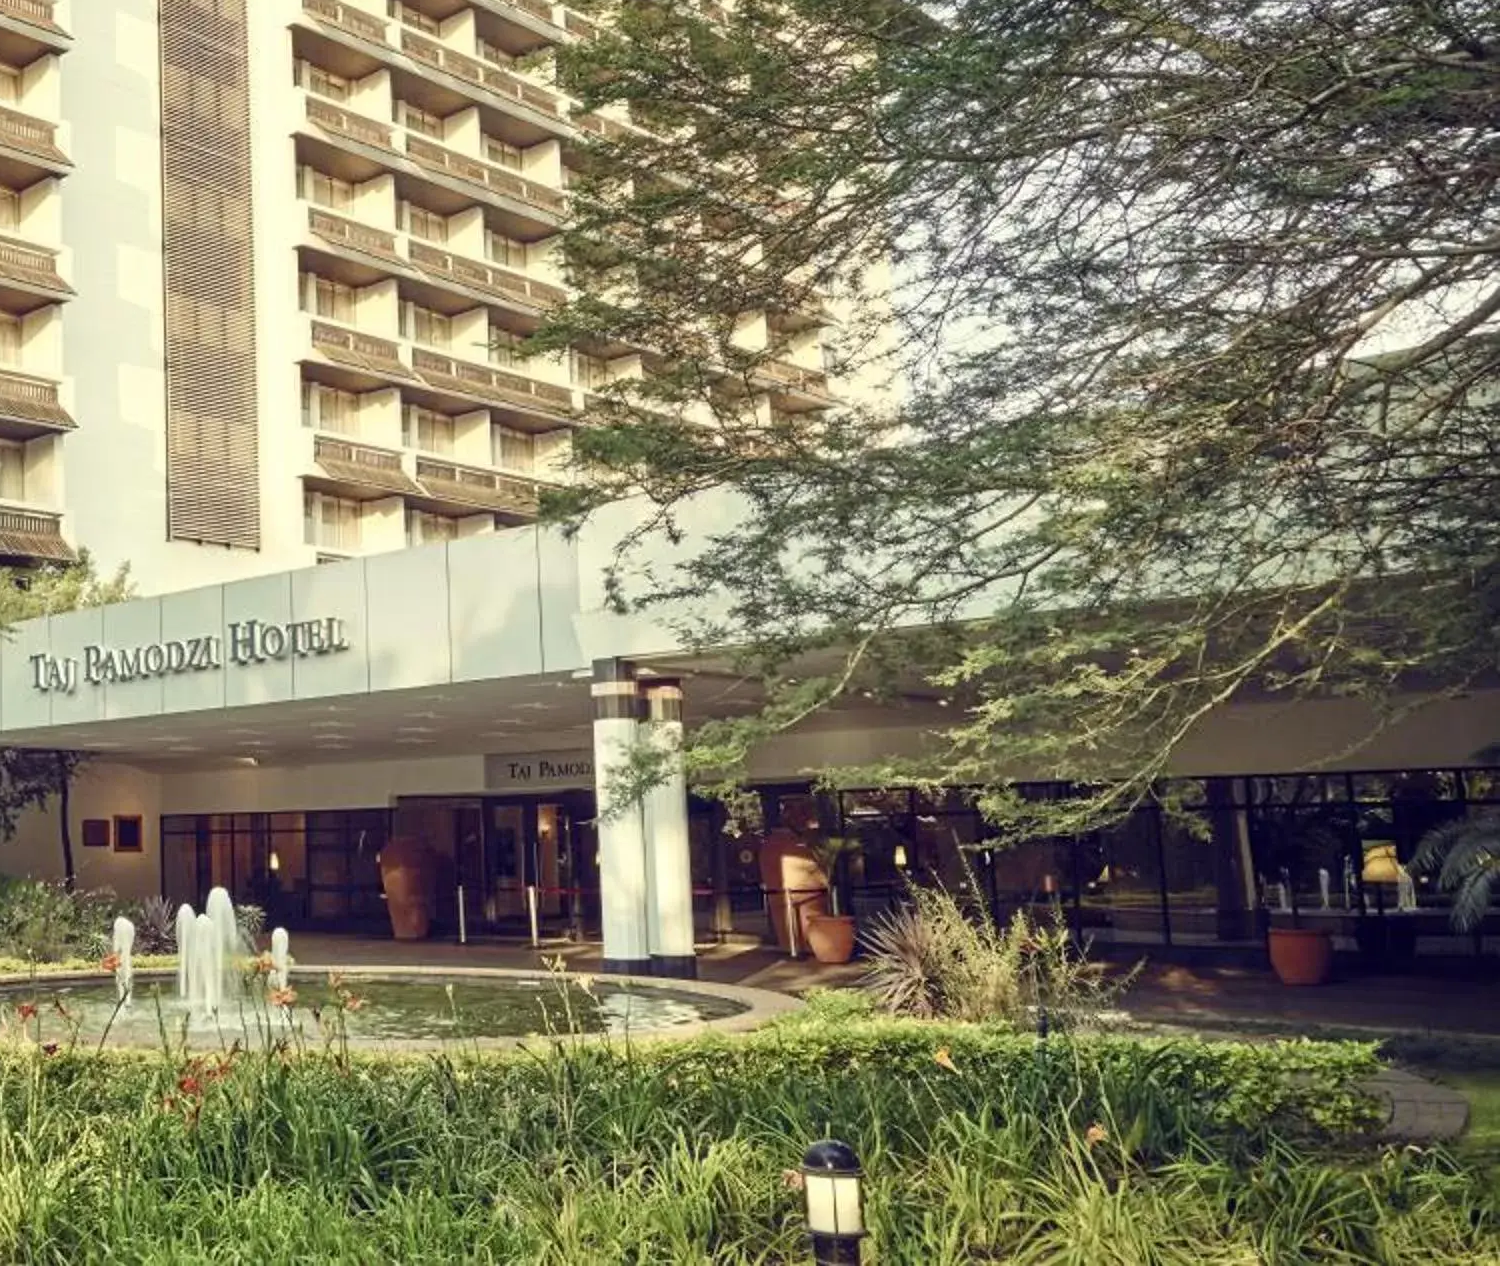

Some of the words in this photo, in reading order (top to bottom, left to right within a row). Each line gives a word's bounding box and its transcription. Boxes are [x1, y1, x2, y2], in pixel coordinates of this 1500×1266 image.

[29, 652, 77, 695] TAJ
[84, 634, 221, 685] PAMODZI
[228, 616, 349, 665] HOTEL
[538, 759, 594, 778] PAMOD
